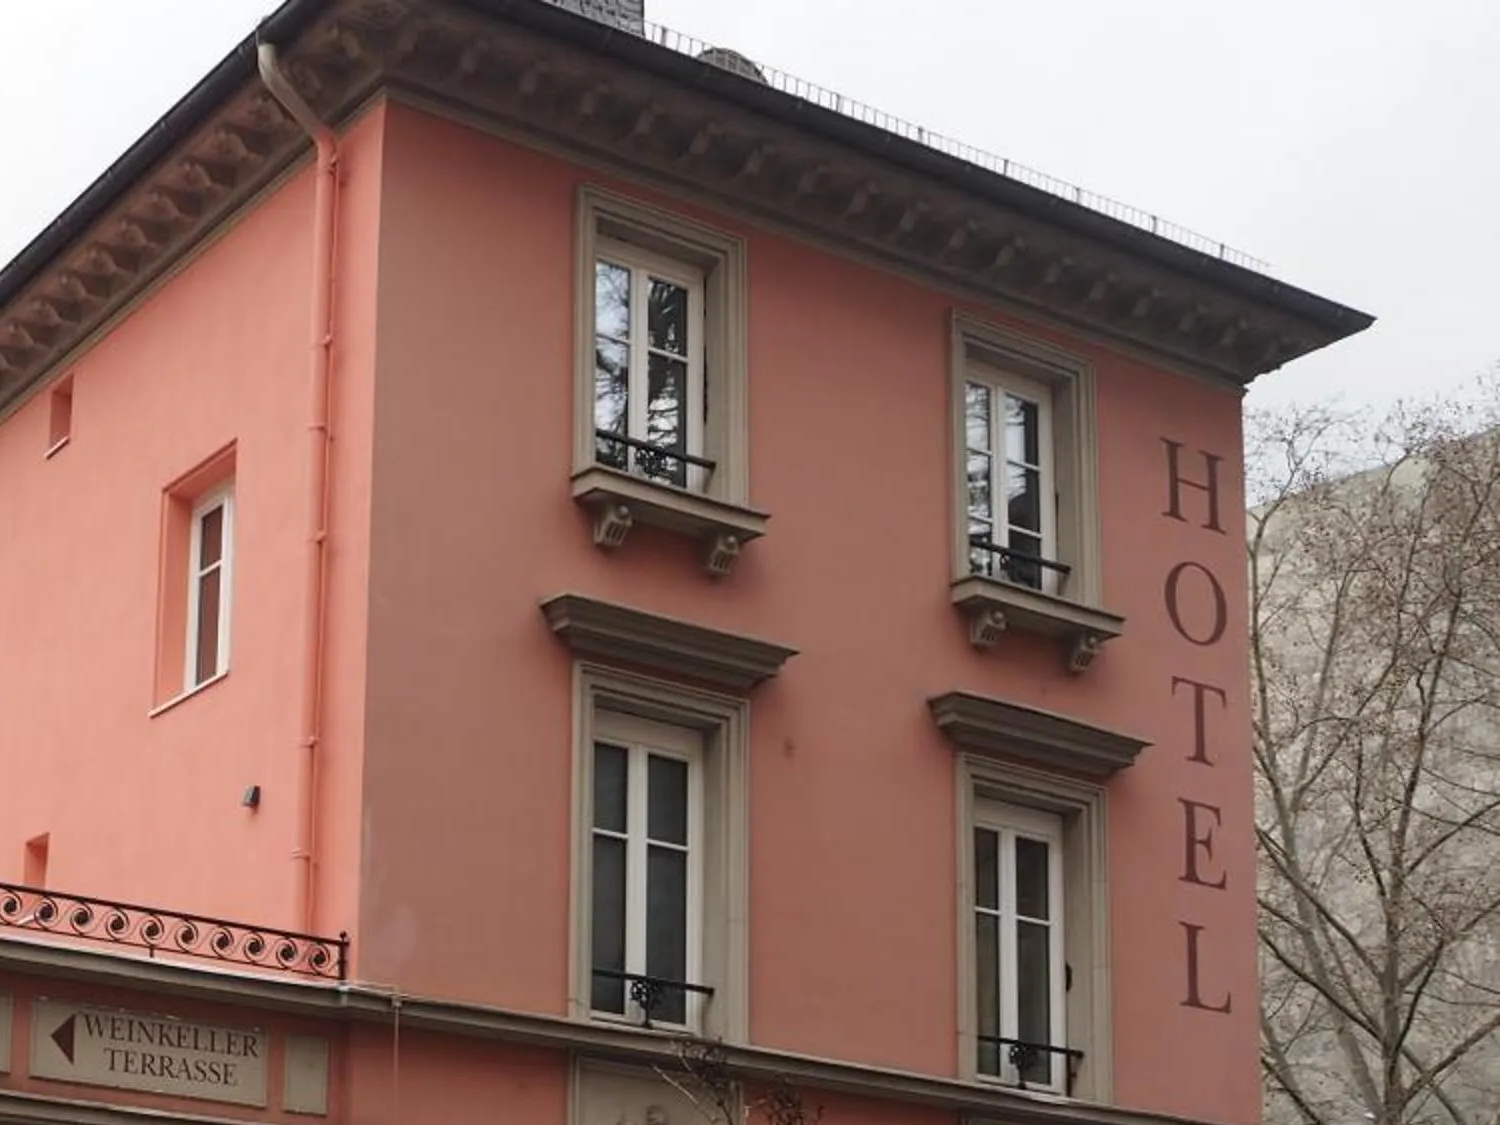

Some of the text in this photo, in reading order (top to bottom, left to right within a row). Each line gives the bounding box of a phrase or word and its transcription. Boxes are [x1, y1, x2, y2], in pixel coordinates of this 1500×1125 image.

[1160, 437, 1231, 1014] HOTEL
[85, 1013, 260, 1058] WEINKELLER
[103, 1047, 239, 1086] TERRASSE
